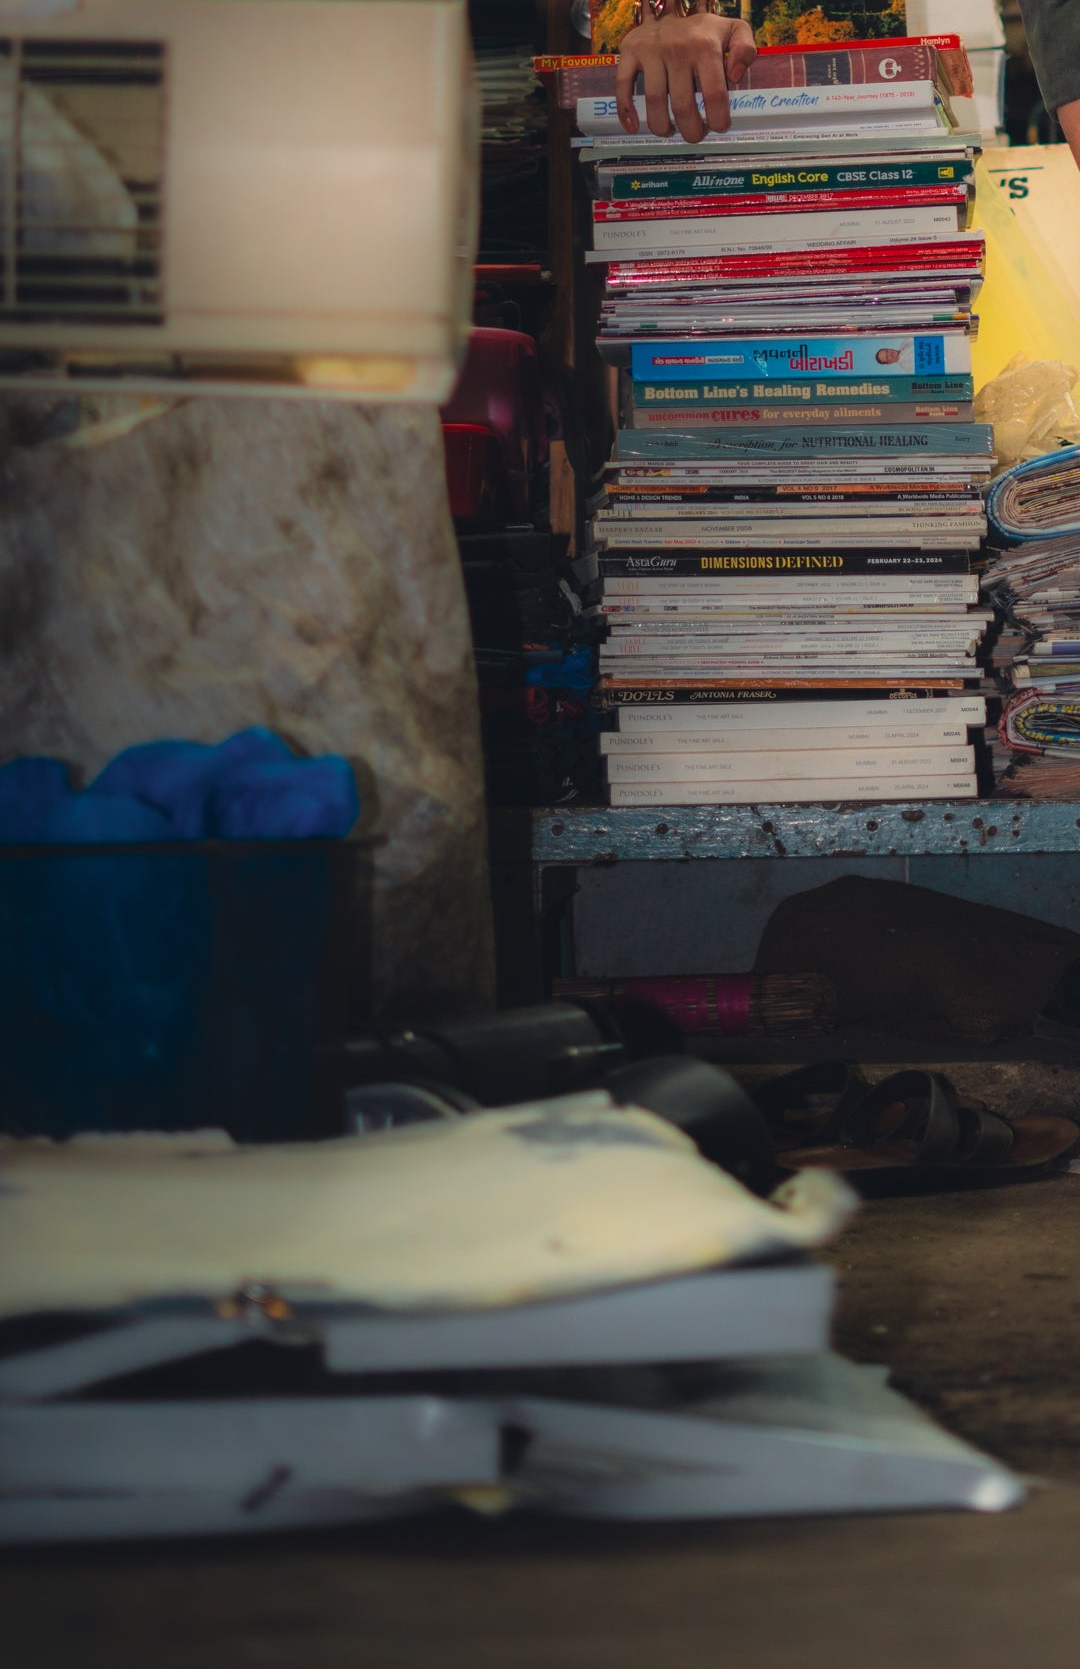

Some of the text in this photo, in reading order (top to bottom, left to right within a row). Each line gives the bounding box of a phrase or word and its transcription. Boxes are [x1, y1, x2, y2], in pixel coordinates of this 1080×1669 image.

[919, 36, 951, 47] Hamlyn
[541, 55, 612, 72] My Favourite
[770, 92, 820, 109] Creation
[856, 92, 879, 101] Journey
[640, 168, 913, 189] arihant English Core CBSE Class 12
[789, 193, 819, 201] DECEMBER
[674, 199, 702, 207] Publication
[602, 230, 647, 239] PUNDOLE'S
[644, 381, 964, 400] Bottom Line's Healing Remedies Bottom Line
[648, 411, 709, 422] uncommon
[711, 409, 761, 423] cures
[762, 409, 779, 419] for
[783, 408, 831, 422] everyday
[833, 407, 882, 418] ailments
[801, 435, 877, 449] NUTRITIONAL
[879, 434, 929, 448] HEALING
[953, 435, 971, 444] Avery
[883, 466, 936, 474] COSMOPOLITAN.IN
[822, 483, 837, 491] 2017
[945, 492, 973, 500] Publication
[599, 520, 981, 534] HARPER'S BAZAAR NOVEMBER THINKING FASHION
[625, 555, 678, 569] AstaGuru
[701, 555, 773, 570] DIMENSIONS
[775, 554, 844, 569] DEFINED
[867, 557, 902, 565] FEBRUARY
[926, 556, 943, 564] 2024
[617, 690, 777, 702] DOLLS ANTONIA FRASER
[628, 713, 673, 722] PUNDOLE'S
[608, 737, 654, 746] PUNDOLE'S
[615, 763, 662, 772] PUNDOLE'S
[619, 789, 664, 798] PUNDOLE'S
